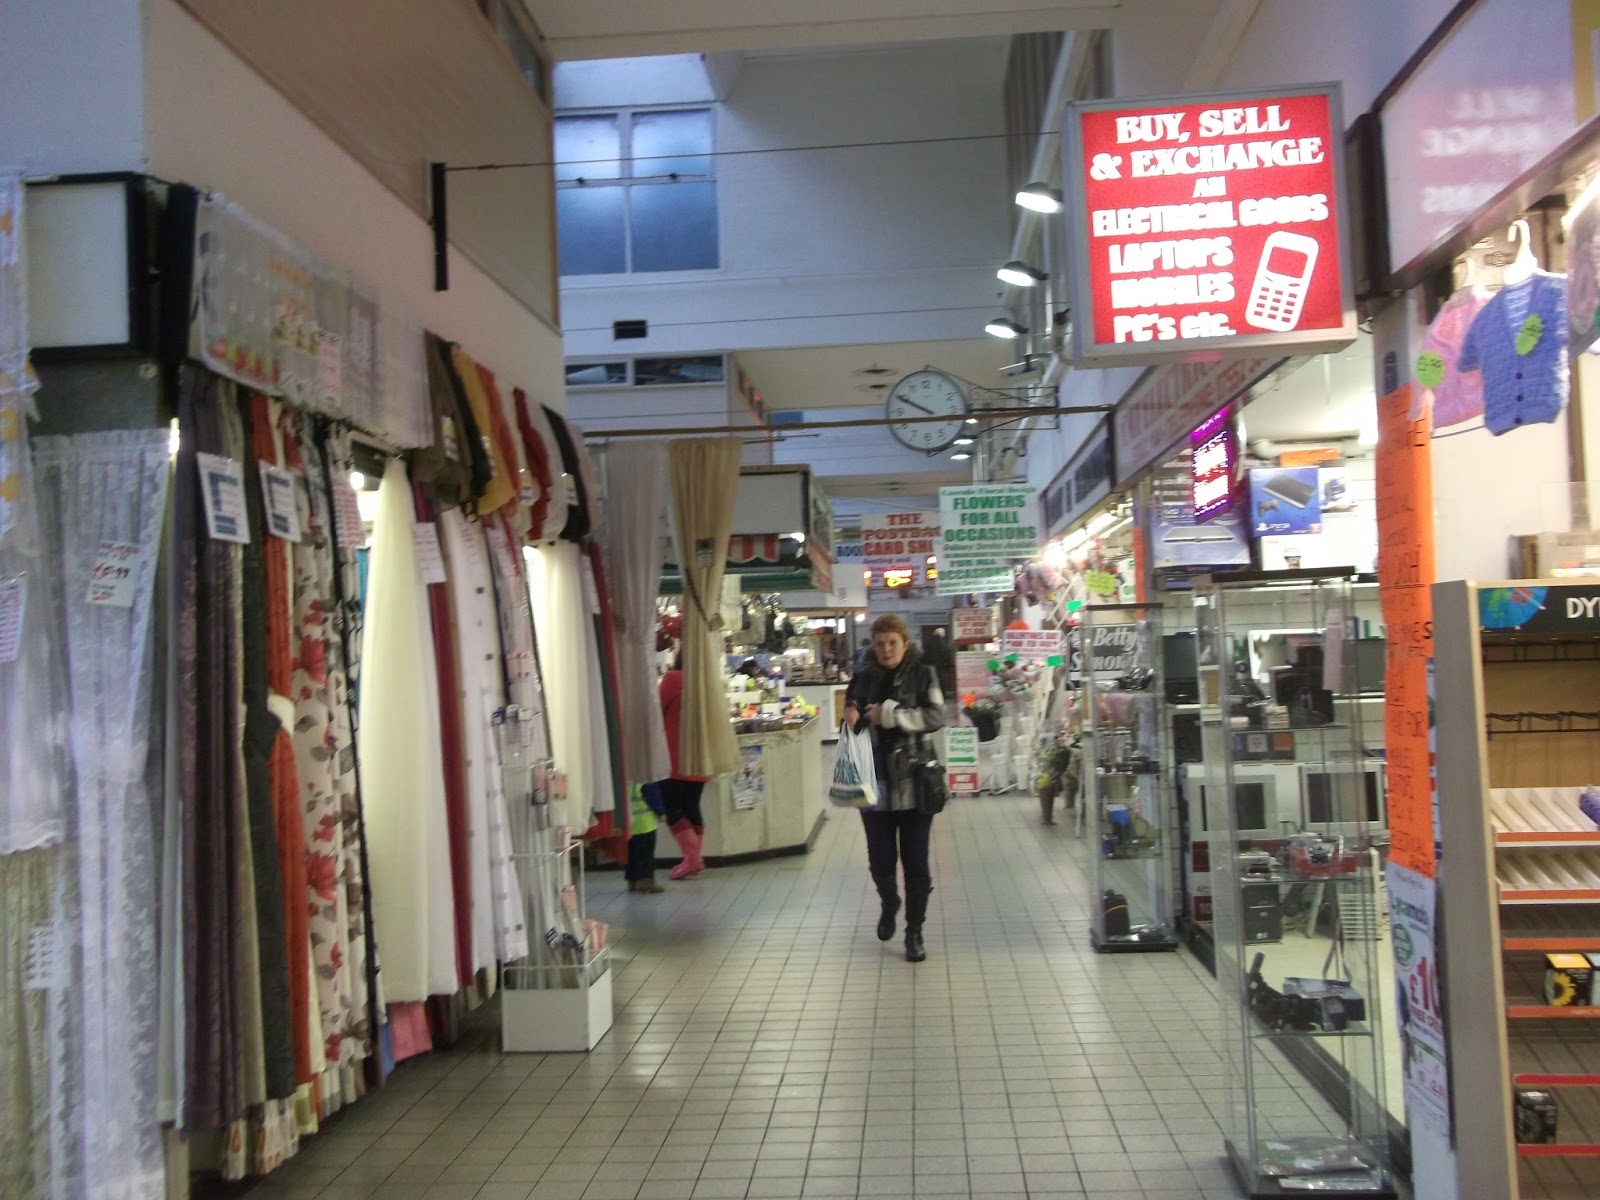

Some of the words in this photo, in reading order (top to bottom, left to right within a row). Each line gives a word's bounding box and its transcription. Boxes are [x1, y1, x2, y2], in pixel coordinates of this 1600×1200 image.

[1115, 111, 1191, 144] BUY,
[1198, 105, 1291, 137] SELL
[1090, 152, 1123, 181] &
[1130, 136, 1325, 178] EXCHANGE
[1092, 200, 1238, 237] ELECTRICAL
[1238, 193, 1329, 227] GOODS
[1108, 236, 1234, 274] LAPTOPS
[1110, 271, 1236, 309] MOBILES
[953, 495, 1026, 510] FLOWERS
[886, 513, 923, 526] THE
[960, 512, 990, 525] FOR
[993, 511, 1019, 524] ALL
[944, 526, 1037, 542] OCCASIONS
[864, 541, 904, 556] CARD
[939, 566, 1010, 580] OCCASIONS
[1566, 596, 1600, 619] DY
[1092, 627, 1138, 652] Betty
